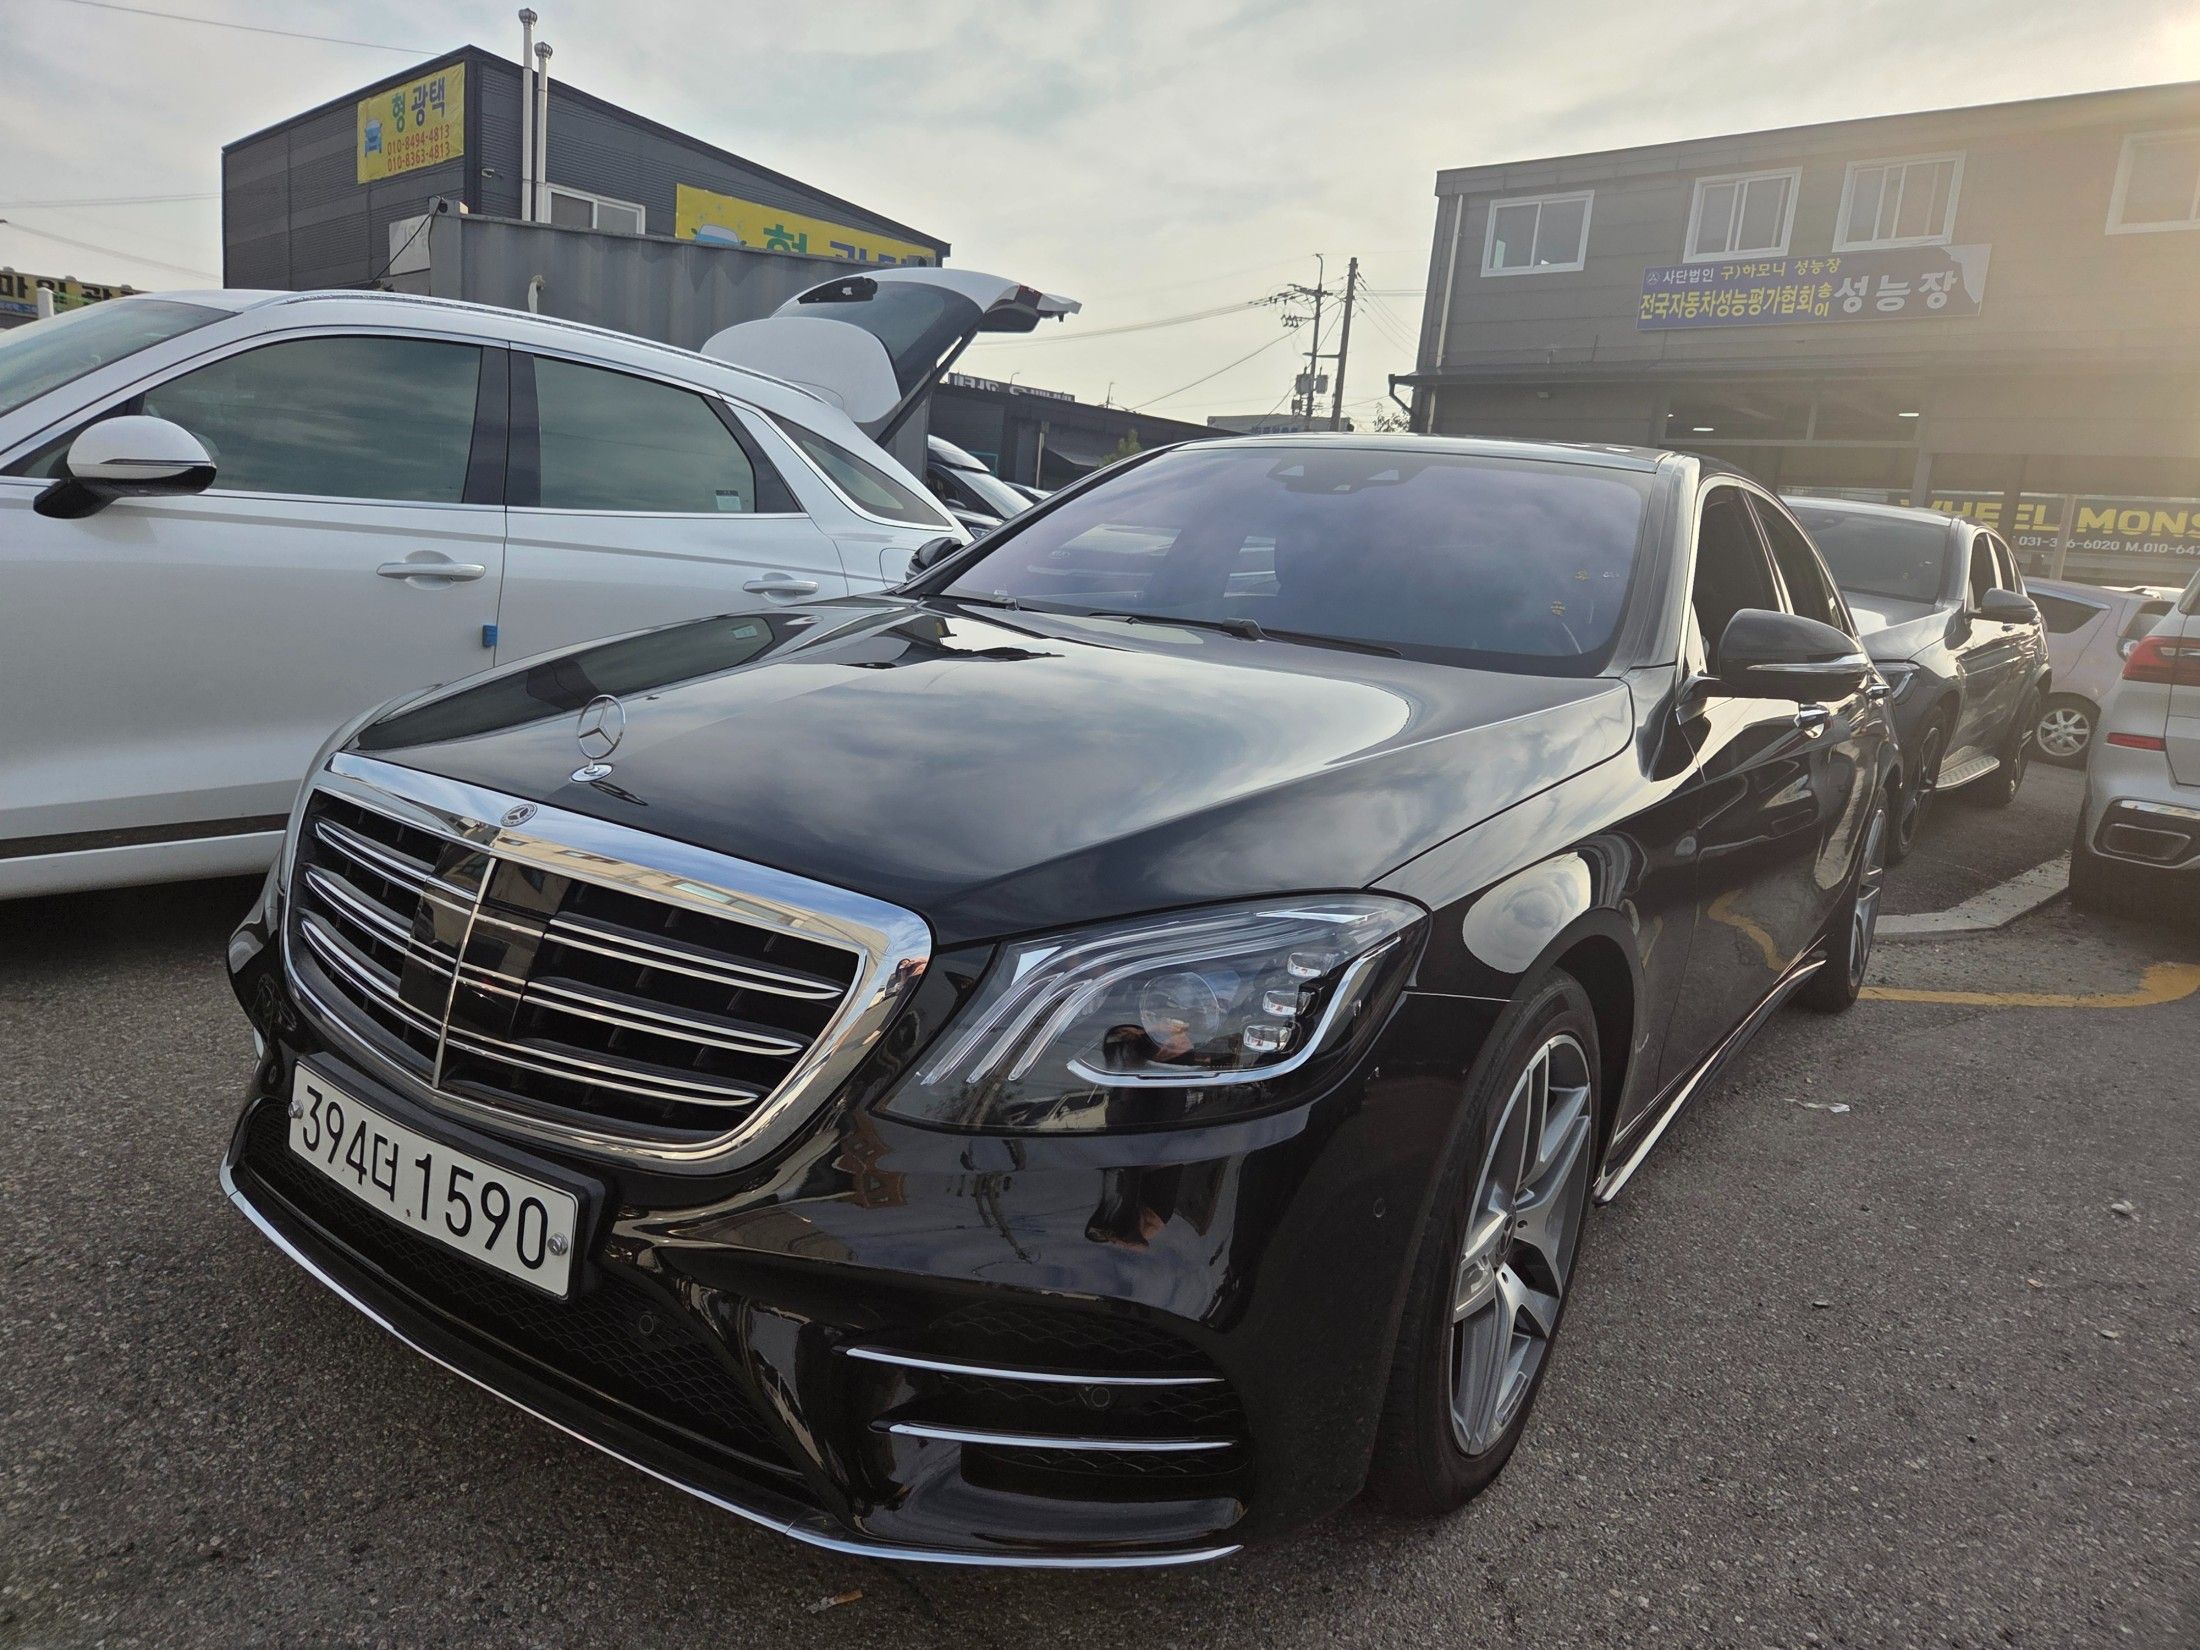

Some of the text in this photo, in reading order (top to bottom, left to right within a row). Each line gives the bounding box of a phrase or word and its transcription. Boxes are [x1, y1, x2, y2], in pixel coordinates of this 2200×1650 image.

[391, 76, 446, 133] 형 광택
[387, 123, 450, 156] 010-8494-4813
[387, 141, 451, 172] 010-8363-4813
[1662, 257, 1842, 285] 사단법인 구)하모니 성능장
[1640, 284, 1815, 321] 전국자동차성능평가협회
[1834, 270, 1959, 314] 성능장
[2019, 535, 2120, 551] 031-36-6020
